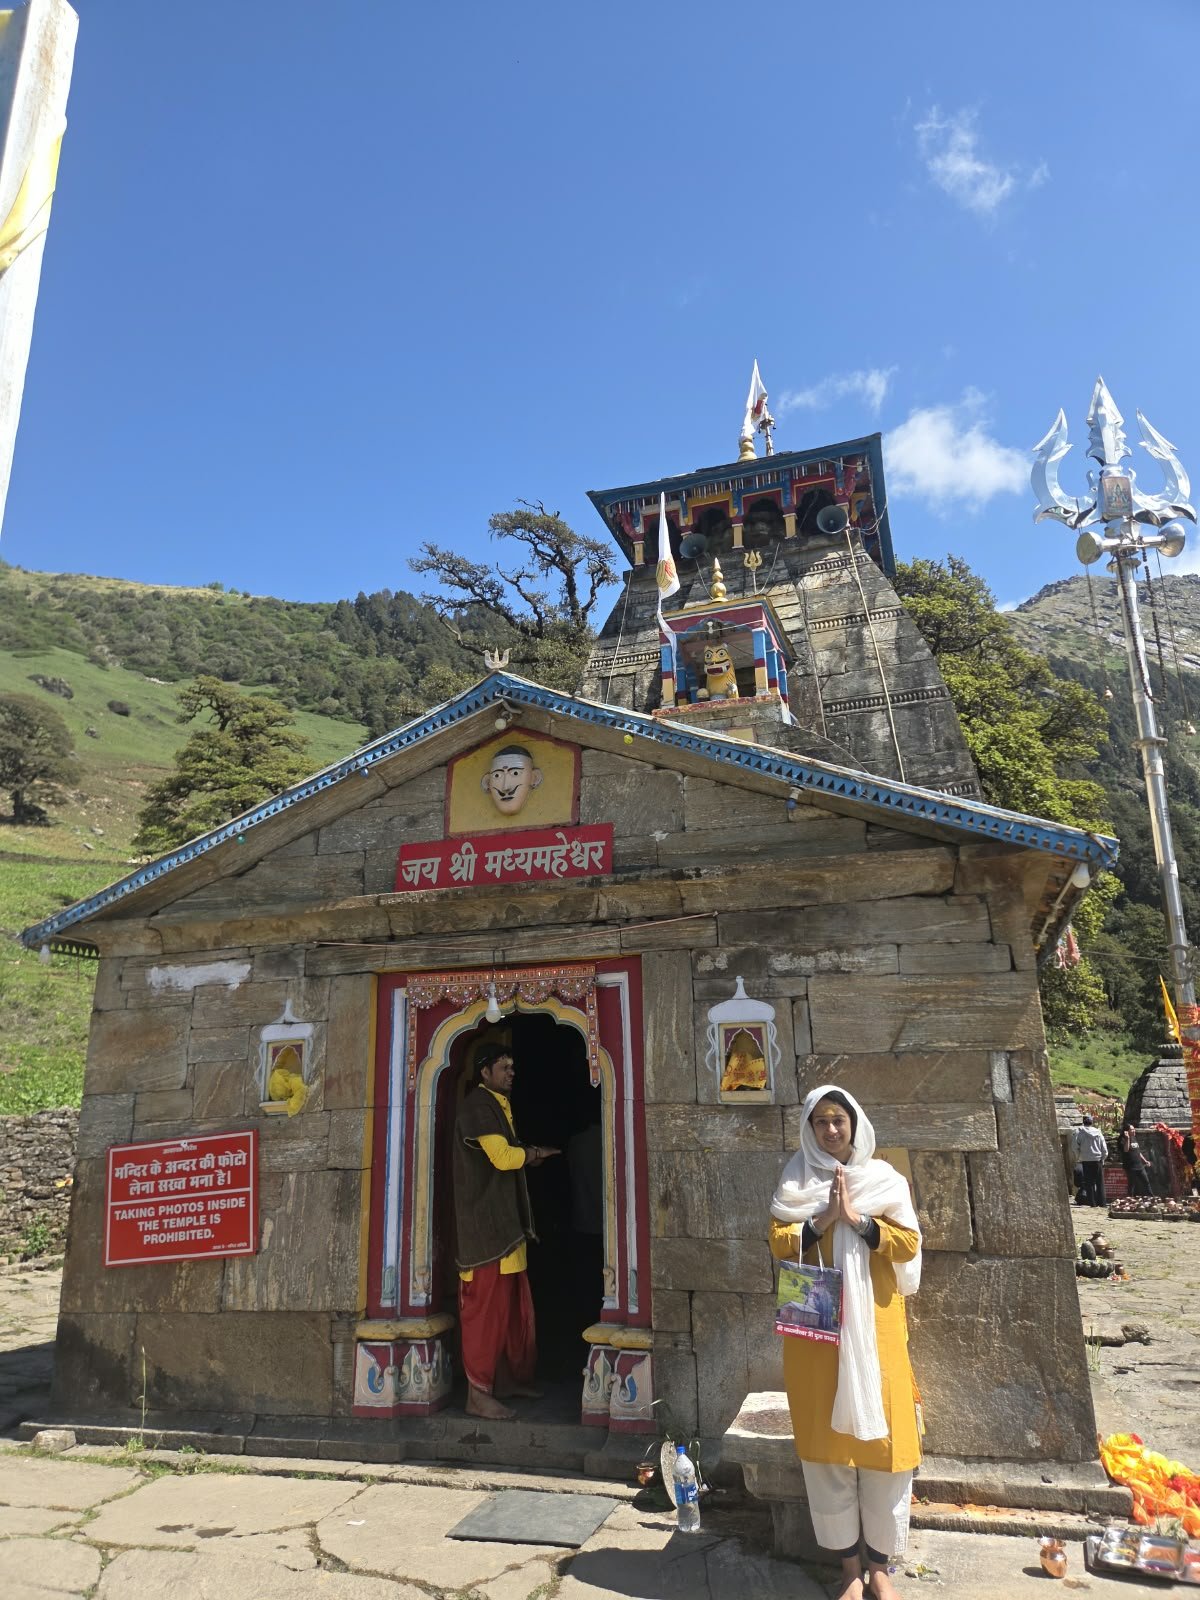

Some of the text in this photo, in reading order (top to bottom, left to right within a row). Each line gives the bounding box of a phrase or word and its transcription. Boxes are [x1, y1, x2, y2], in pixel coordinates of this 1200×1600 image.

[401, 857, 441, 886] जय
[449, 841, 478, 882] श्री
[114, 1162, 148, 1180] मन्दिर
[150, 1159, 162, 1175] के
[165, 1158, 197, 1174] अन्दर
[199, 1153, 215, 1170] की
[218, 1149, 247, 1167] फोटो
[129, 1179, 155, 1196] लेना
[189, 1174, 214, 1188] मना
[114, 1197, 246, 1221] TAKING PHOTOS INSIDE
[138, 1213, 221, 1232] THE TEMPLE IS
[143, 1228, 215, 1245] PROHIBITED.
